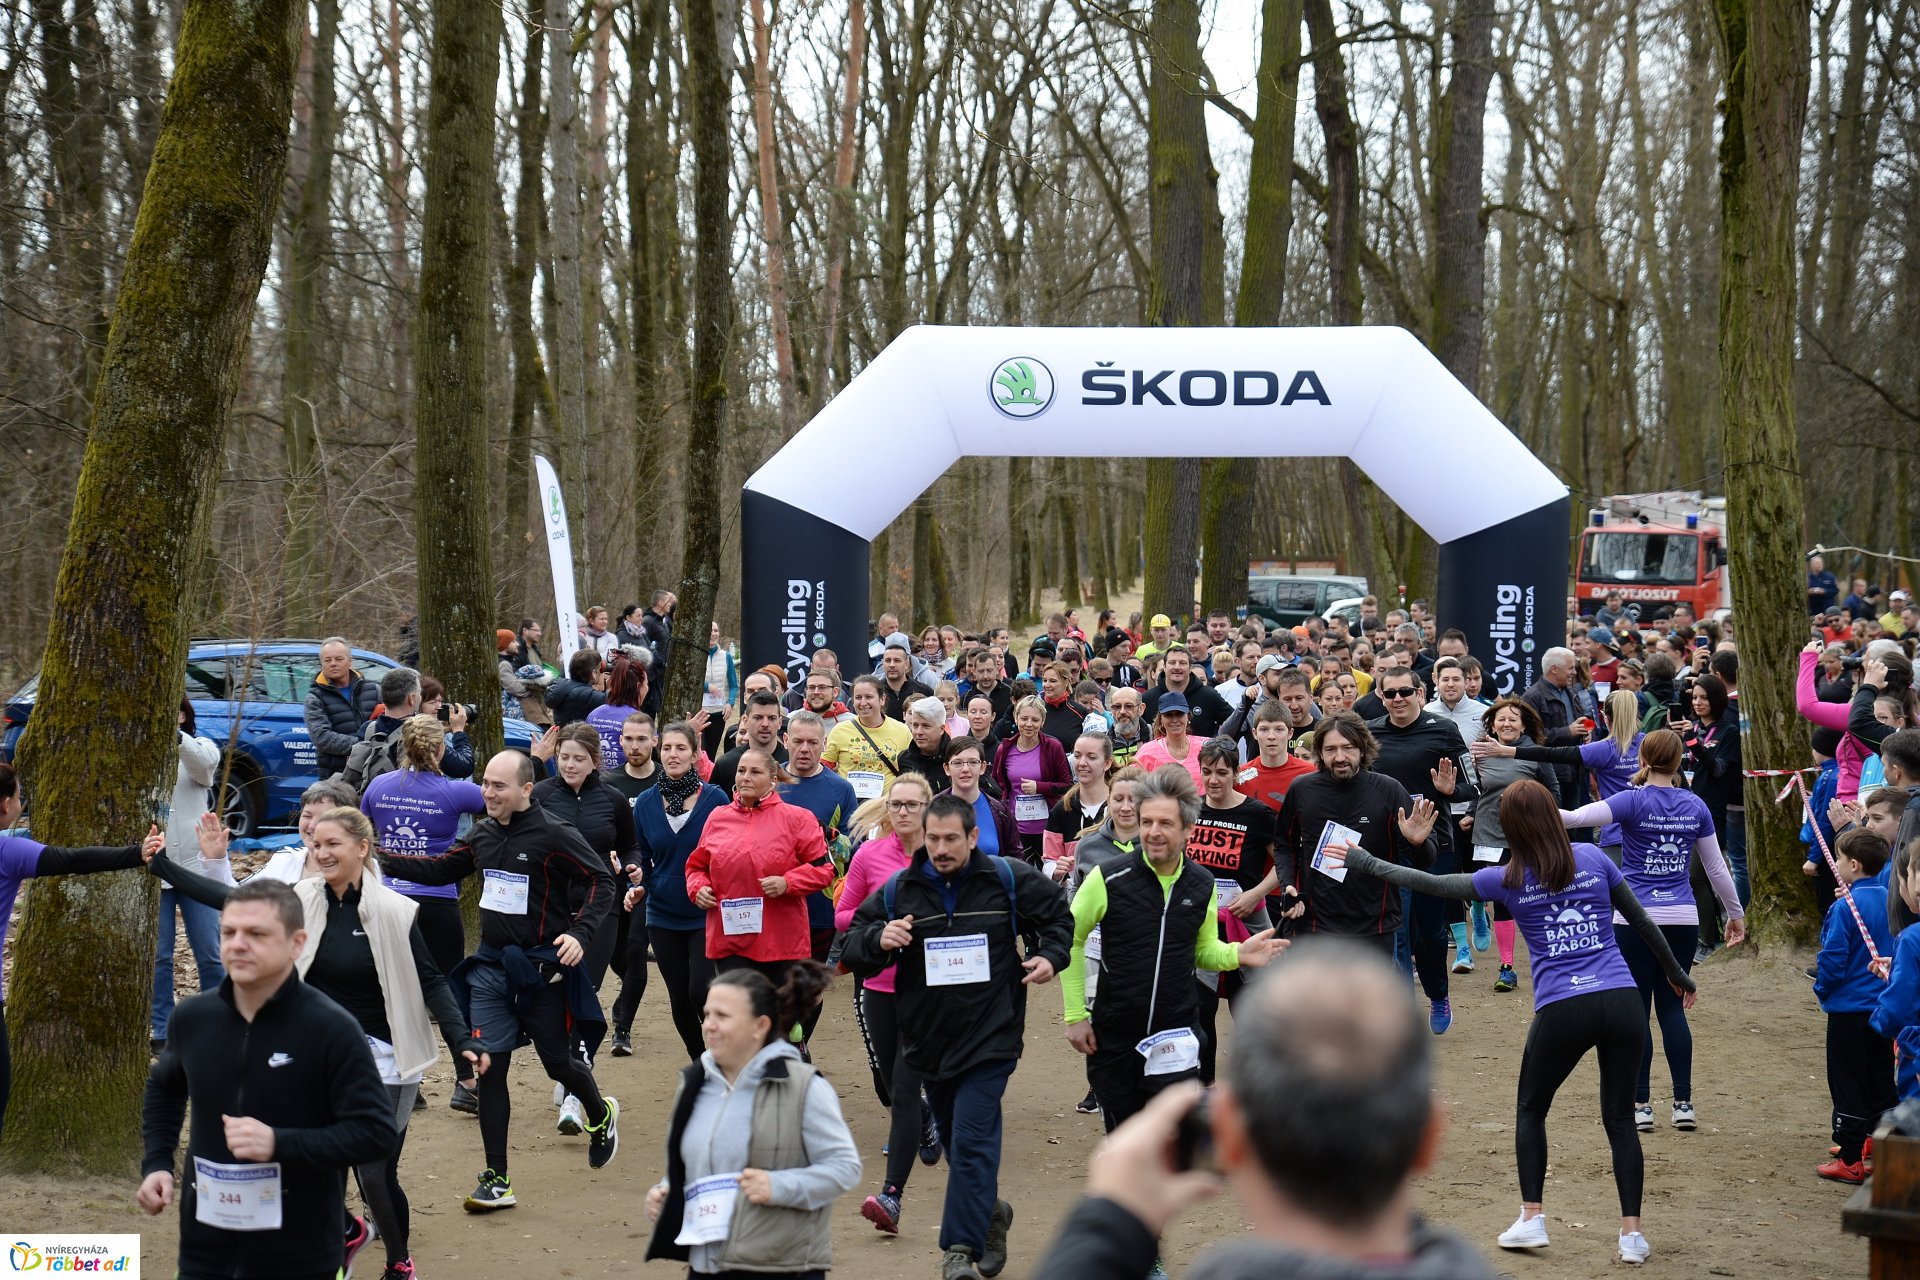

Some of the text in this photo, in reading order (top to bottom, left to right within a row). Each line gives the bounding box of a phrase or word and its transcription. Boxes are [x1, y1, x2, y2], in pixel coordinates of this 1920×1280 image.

[1081, 361, 1332, 406] ŠKODA
[814, 581, 825, 630] ŠKODA
[1523, 586, 1535, 635] ŠKODA
[782, 580, 812, 688] Cycling
[1490, 585, 1522, 695] Cycling
[283, 741, 312, 750] VALENT
[293, 758, 317, 766] TISZAVA
[1213, 820, 1248, 832] PROBLEM
[1190, 827, 1243, 850] JUST
[1186, 847, 1237, 868] SAYING
[1518, 891, 1548, 905] Jótékony
[1577, 875, 1601, 889] vagyok.
[1525, 884, 1535, 893] Én
[738, 911, 751, 920] 157
[1545, 921, 1600, 943] BÁTOR
[1547, 935, 1601, 955] TÁBOR
[947, 957, 964, 967] 144
[1161, 1045, 1175, 1054] 333
[218, 1191, 242, 1205] 244
[698, 1203, 718, 1217] 292
